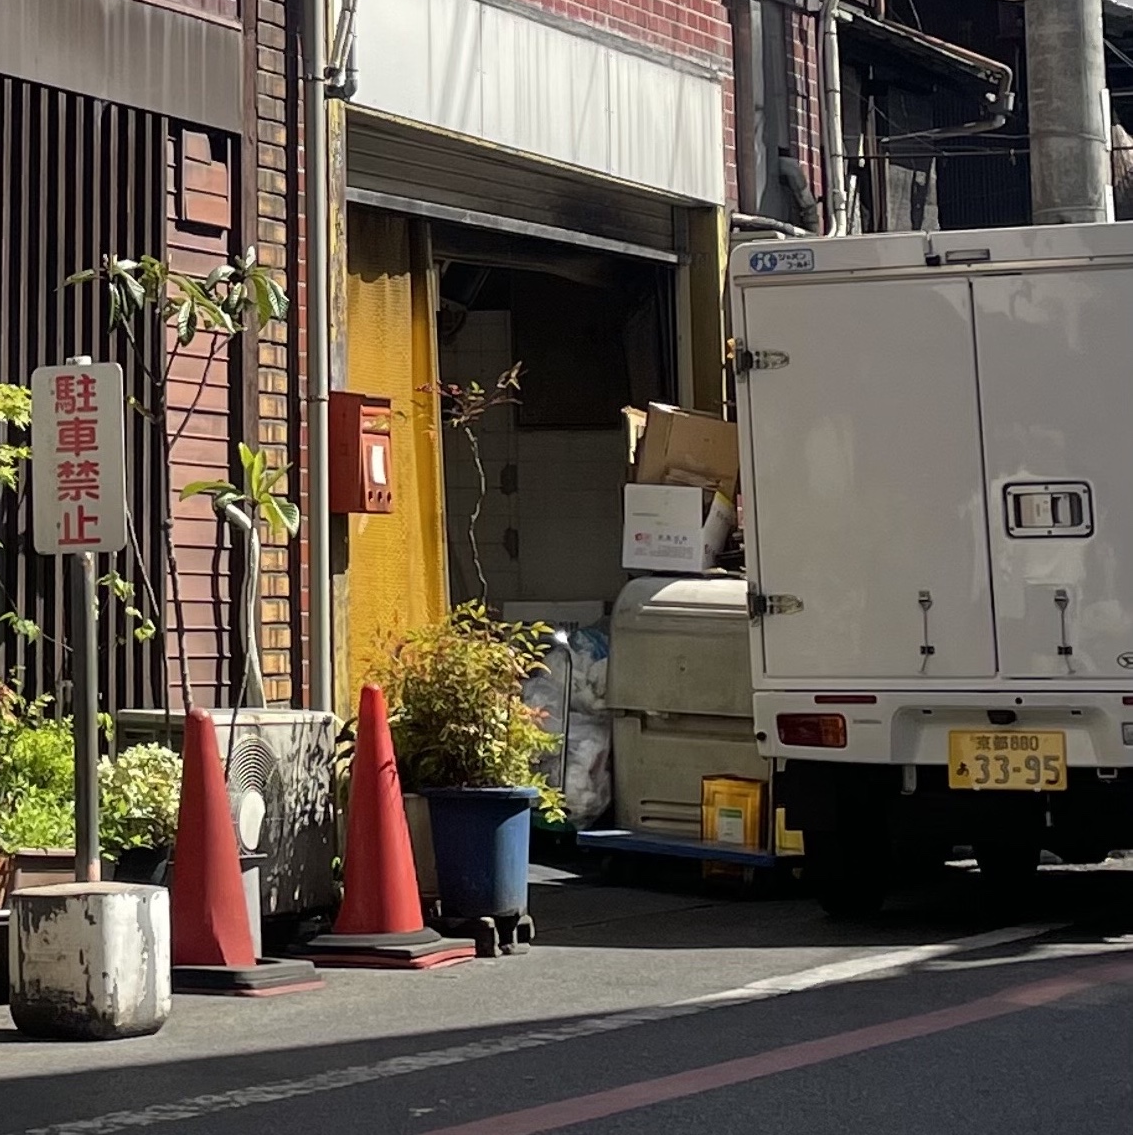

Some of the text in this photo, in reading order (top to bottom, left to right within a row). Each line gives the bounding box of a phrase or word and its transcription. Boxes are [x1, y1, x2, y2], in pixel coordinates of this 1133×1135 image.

[54, 373, 102, 546] 駐車禁止
[975, 754, 1060, 785] 33-95
